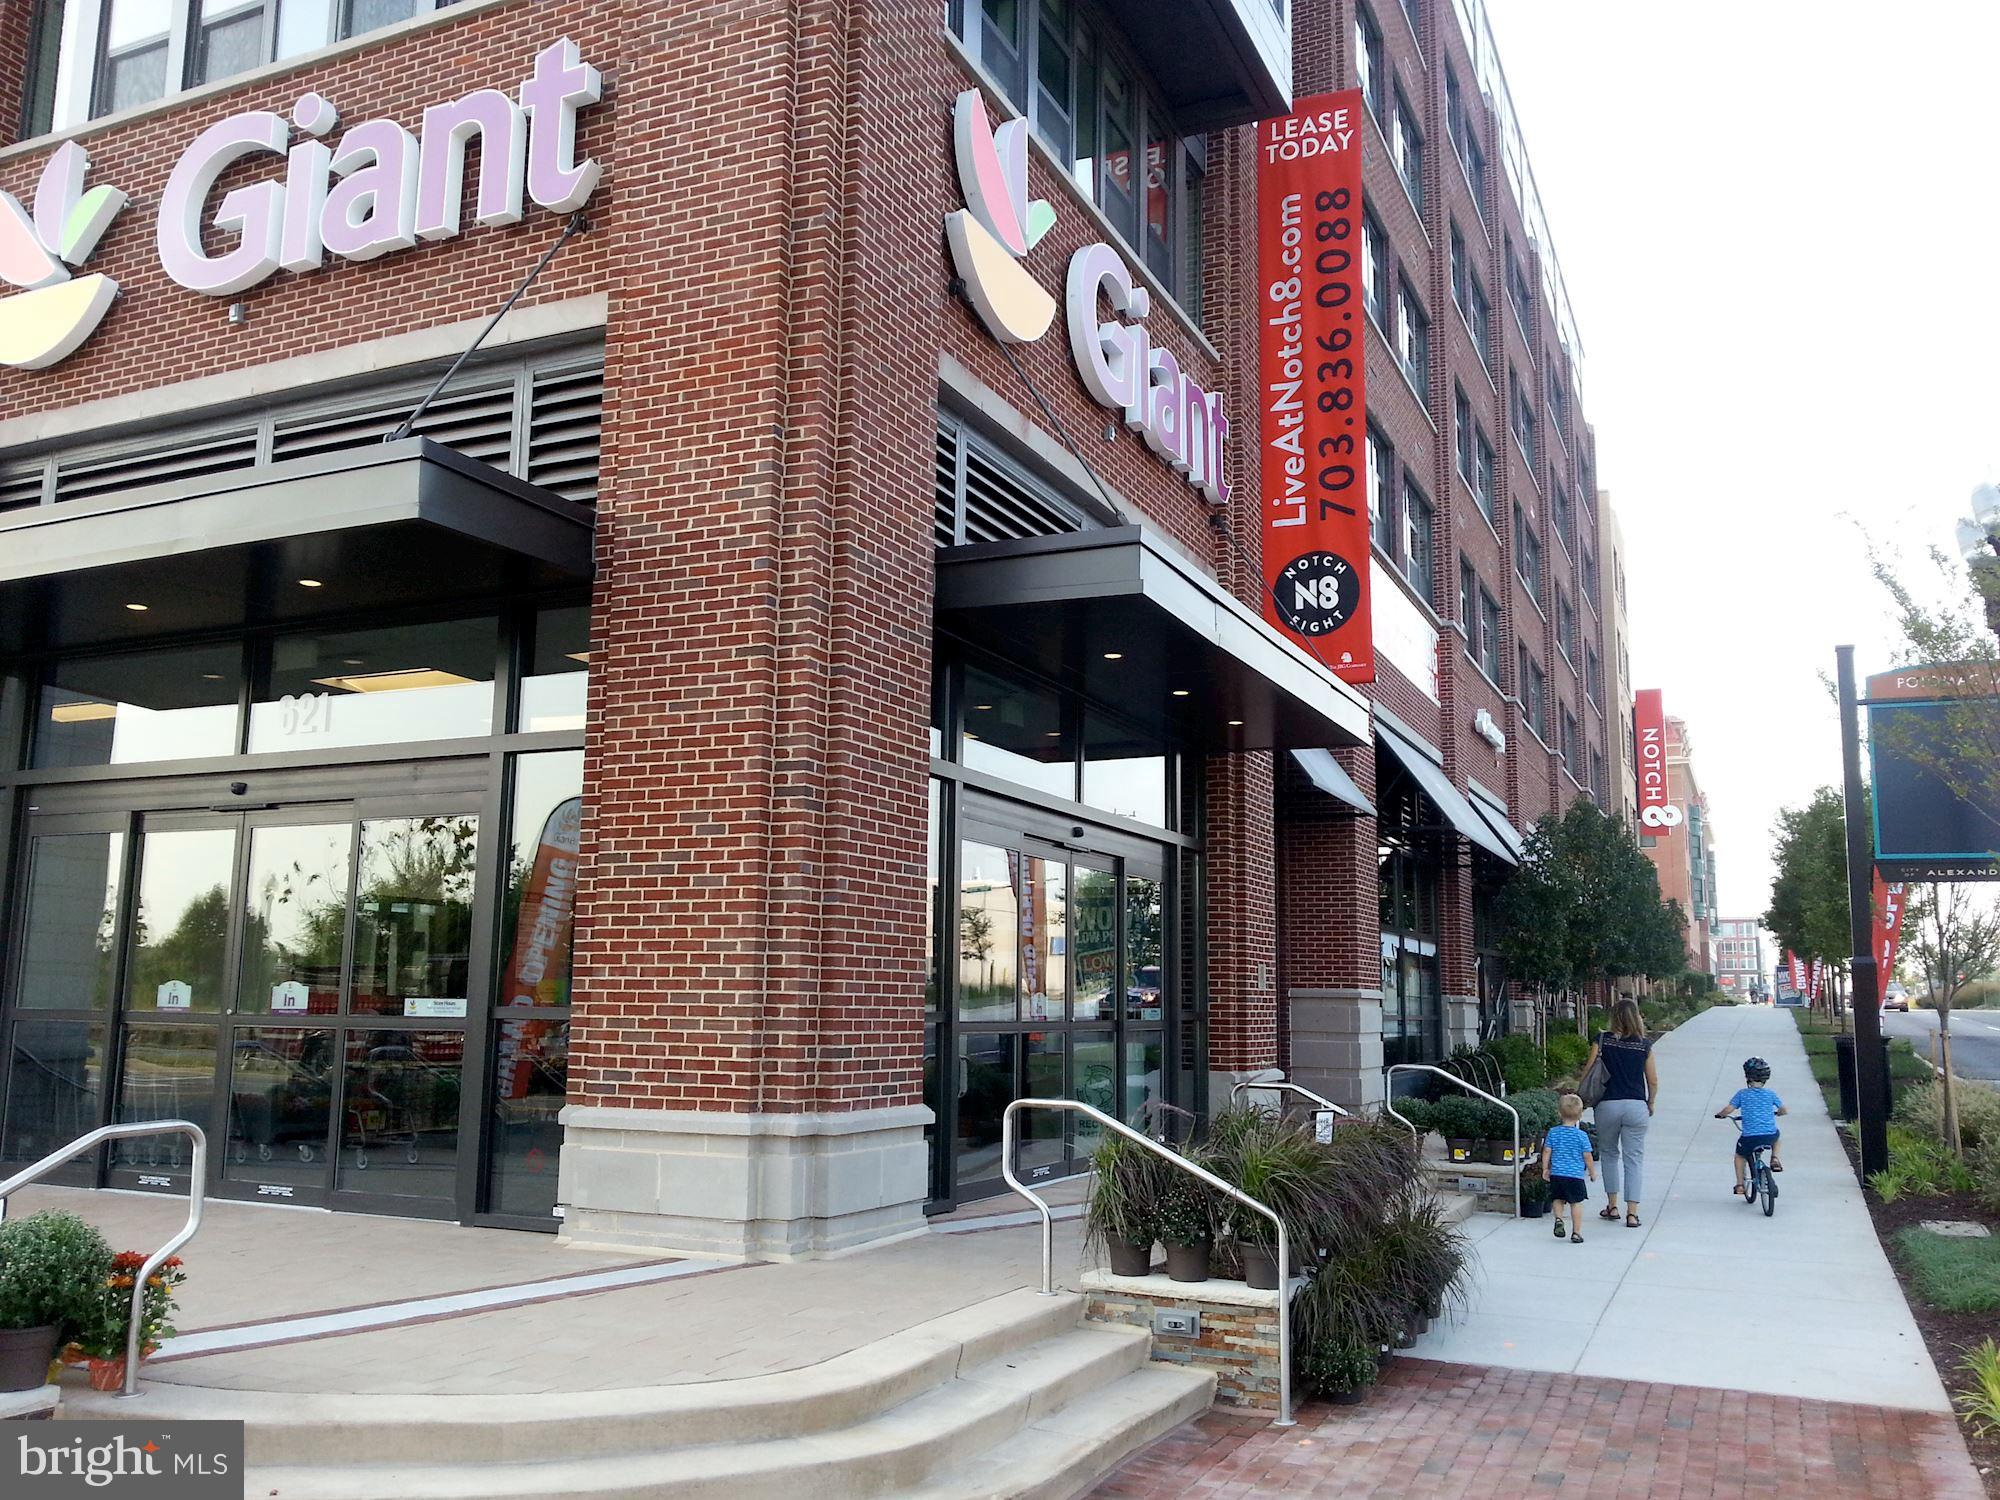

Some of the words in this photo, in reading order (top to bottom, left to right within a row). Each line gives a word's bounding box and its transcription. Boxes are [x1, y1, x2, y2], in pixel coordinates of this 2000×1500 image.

[1271, 108, 1349, 142] LEASE
[1265, 129, 1354, 165] TODAY
[158, 36, 602, 296] Giant
[1270, 193, 1307, 528] LiveAtNotch8.com
[1315, 186, 1356, 521] 703.836.0088
[1066, 242, 1232, 505] Giant
[1284, 555, 1347, 580] NOTCH
[1294, 575, 1339, 611] N8
[1289, 609, 1344, 633] EIGHT
[280, 692, 333, 736] 621
[1643, 728, 1662, 800] NOTCH
[1927, 868, 1998, 876] ALEXAND
[519, 857, 577, 986] OPENING
[167, 992, 179, 1005] In
[284, 993, 295, 1007] In
